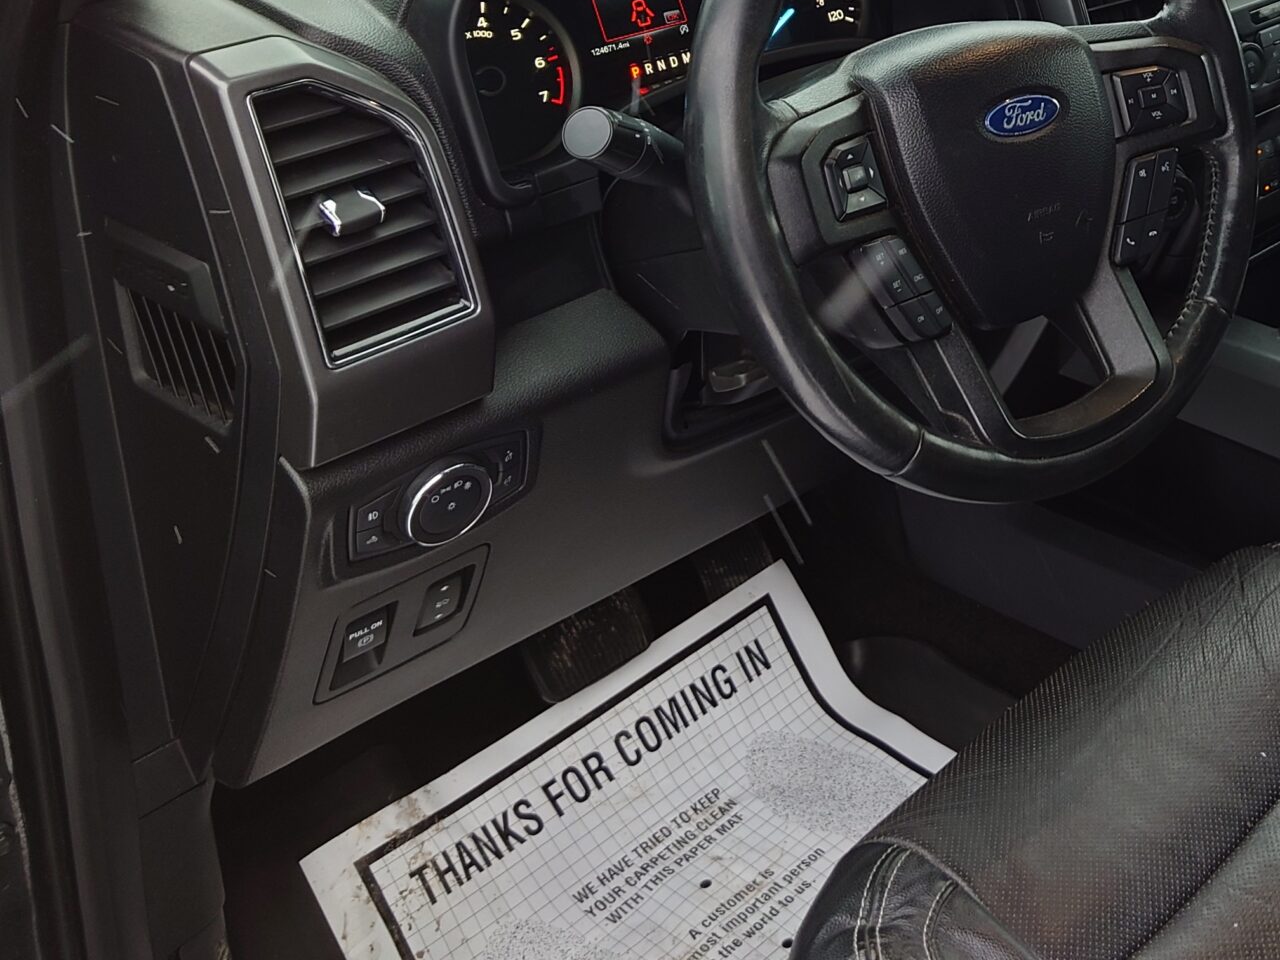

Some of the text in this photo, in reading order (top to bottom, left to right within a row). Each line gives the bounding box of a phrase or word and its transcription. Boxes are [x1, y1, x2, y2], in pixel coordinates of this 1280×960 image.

[477, 17, 488, 28] 4
[827, 9, 844, 22] 120
[510, 28, 522, 40] 5
[534, 56, 546, 69] 6
[631, 65, 640, 78] P
[644, 63, 654, 75] R
[657, 60, 667, 71] N
[670, 56, 679, 68] D
[538, 90, 548, 103] 7
[1003, 99, 1047, 130] Ford
[1151, 110, 1163, 118] VOL
[349, 619, 383, 640] PULL ON
[409, 638, 772, 905] THANKS FOR COMING IN
[572, 788, 721, 904] WE HAVE TRIED TO KEEP
[584, 798, 738, 918] YOUR CARPETING CLEAN
[605, 811, 744, 924] WITH THIS PAPER MAT
[719, 882, 783, 933] important
[782, 847, 826, 884] person
[688, 868, 775, 940] A customer is
[718, 879, 817, 959] the world to us.
